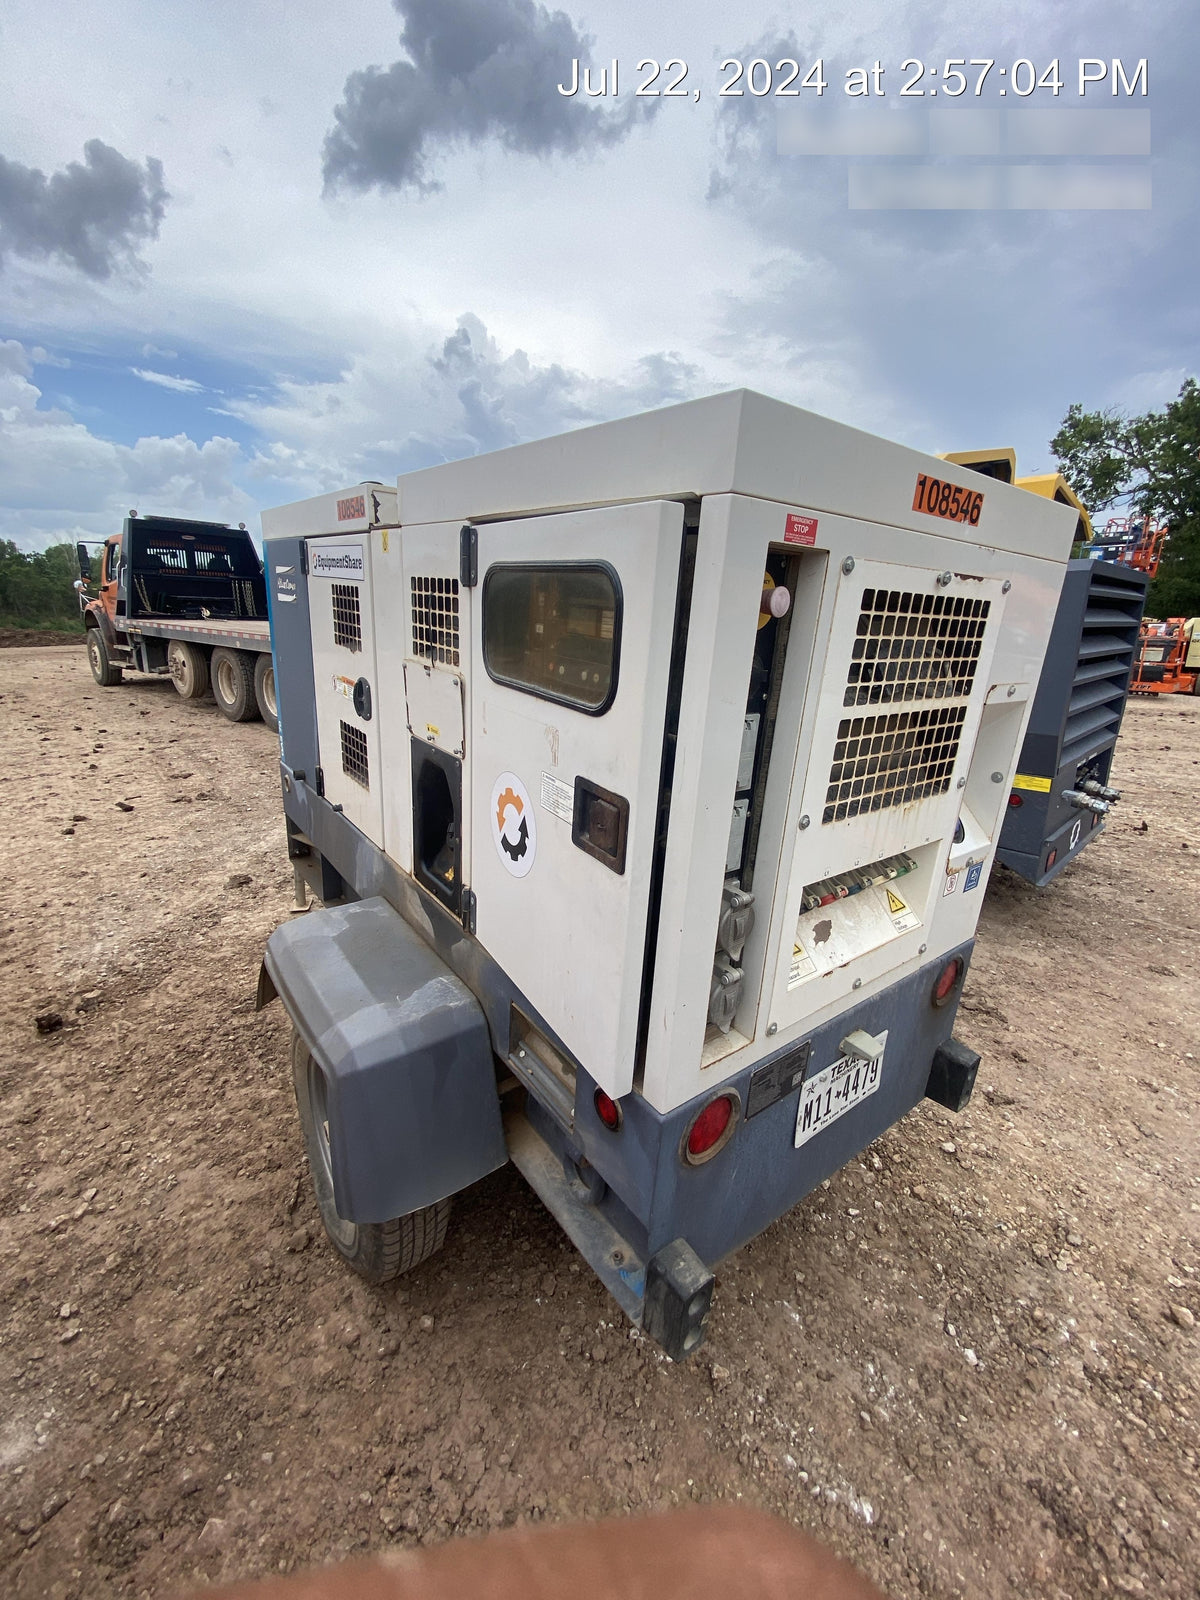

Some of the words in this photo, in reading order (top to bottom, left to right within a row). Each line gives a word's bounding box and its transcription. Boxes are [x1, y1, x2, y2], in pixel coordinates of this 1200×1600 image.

[917, 475, 984, 525] 108546
[791, 515, 814, 525] EMERGENCY
[793, 523, 809, 534] STOP
[317, 554, 363, 571] EquipmentShare
